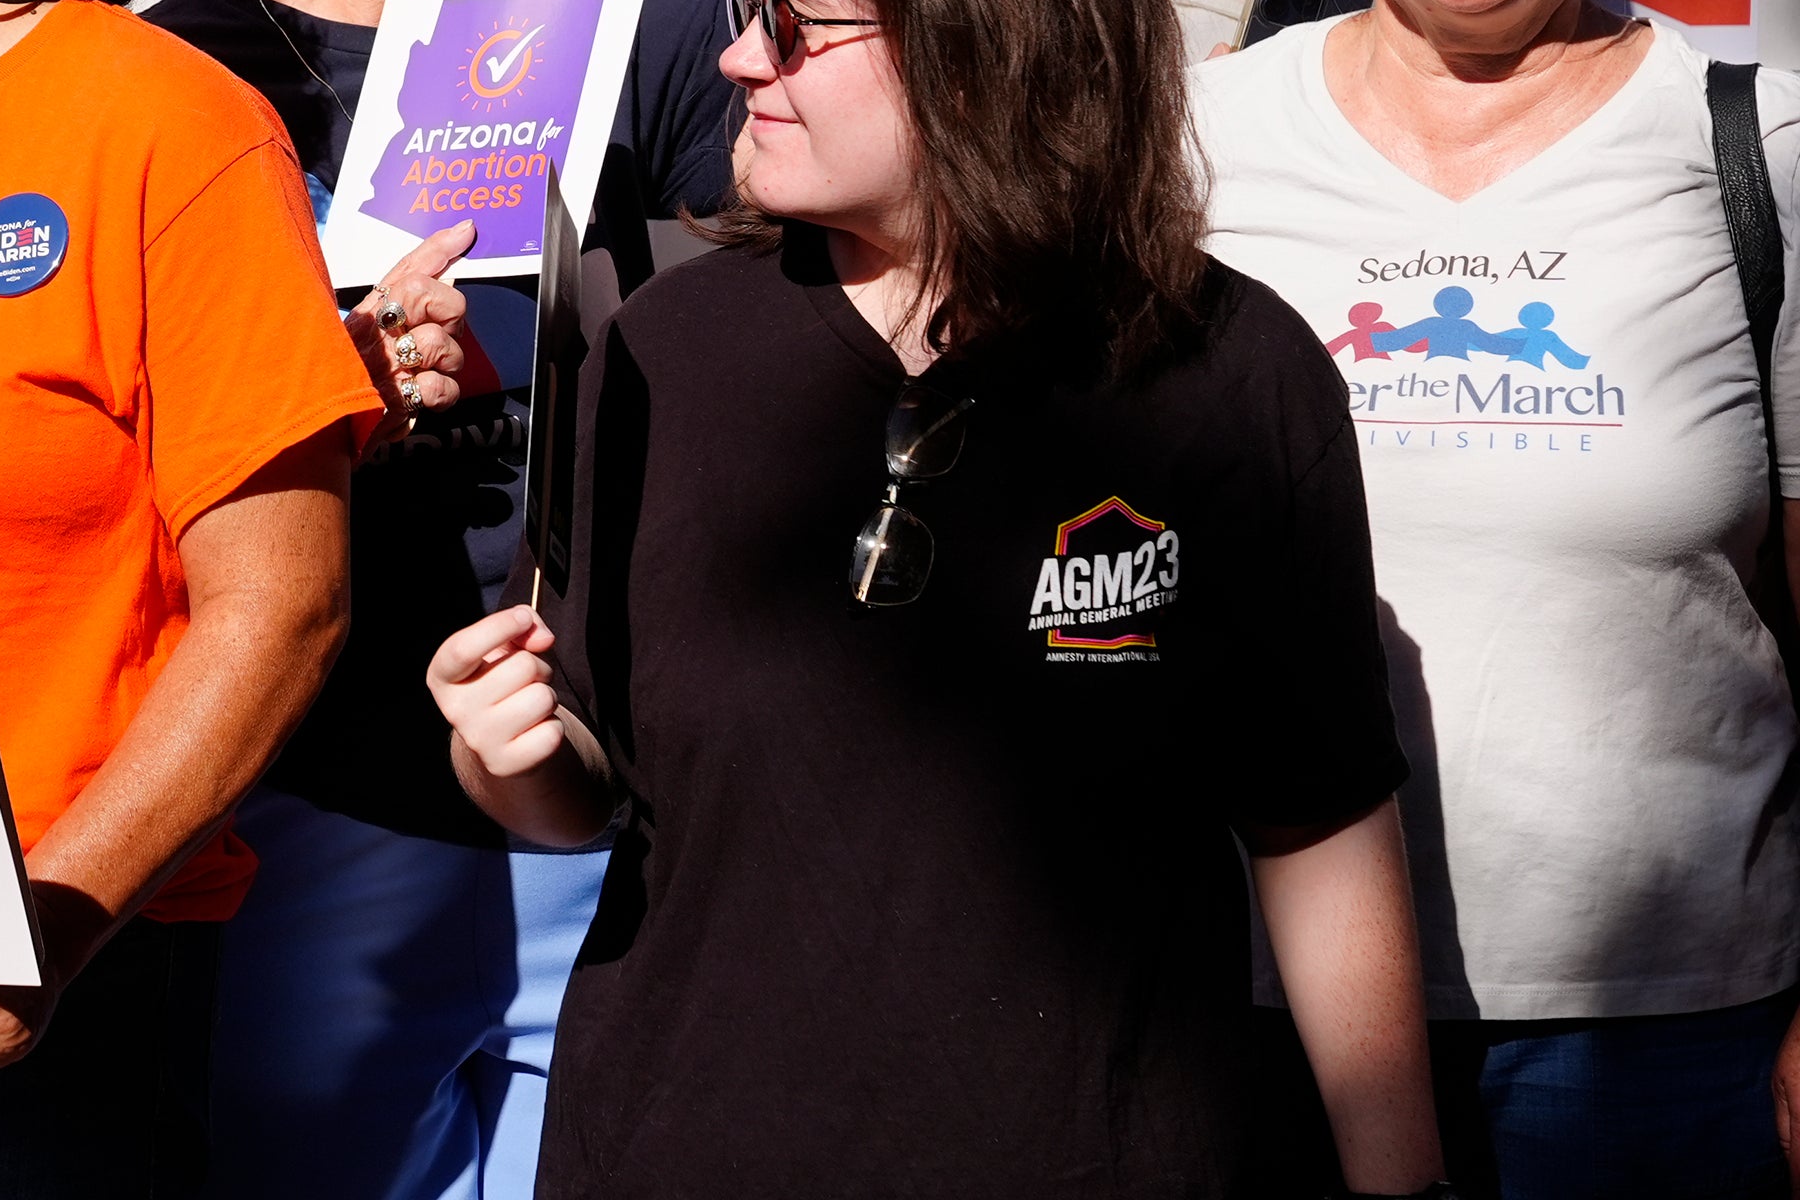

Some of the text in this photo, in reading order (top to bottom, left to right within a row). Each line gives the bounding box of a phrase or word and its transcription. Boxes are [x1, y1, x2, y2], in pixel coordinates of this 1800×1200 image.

[403, 117, 564, 155] Arizona for
[401, 149, 547, 187] Abortion
[408, 184, 524, 214] Access
[22, 219, 37, 230] for
[1357, 249, 1569, 285] Sedona, AZ
[1396, 372, 1450, 398] the
[1456, 373, 1625, 416] March
[1030, 530, 1179, 615] AGM23
[1028, 612, 1076, 631] ANNUAL
[1079, 605, 1133, 624] GENERAL
[1045, 652, 1085, 662] AMNESTY
[1087, 651, 1148, 663] INTERNATIONAL
